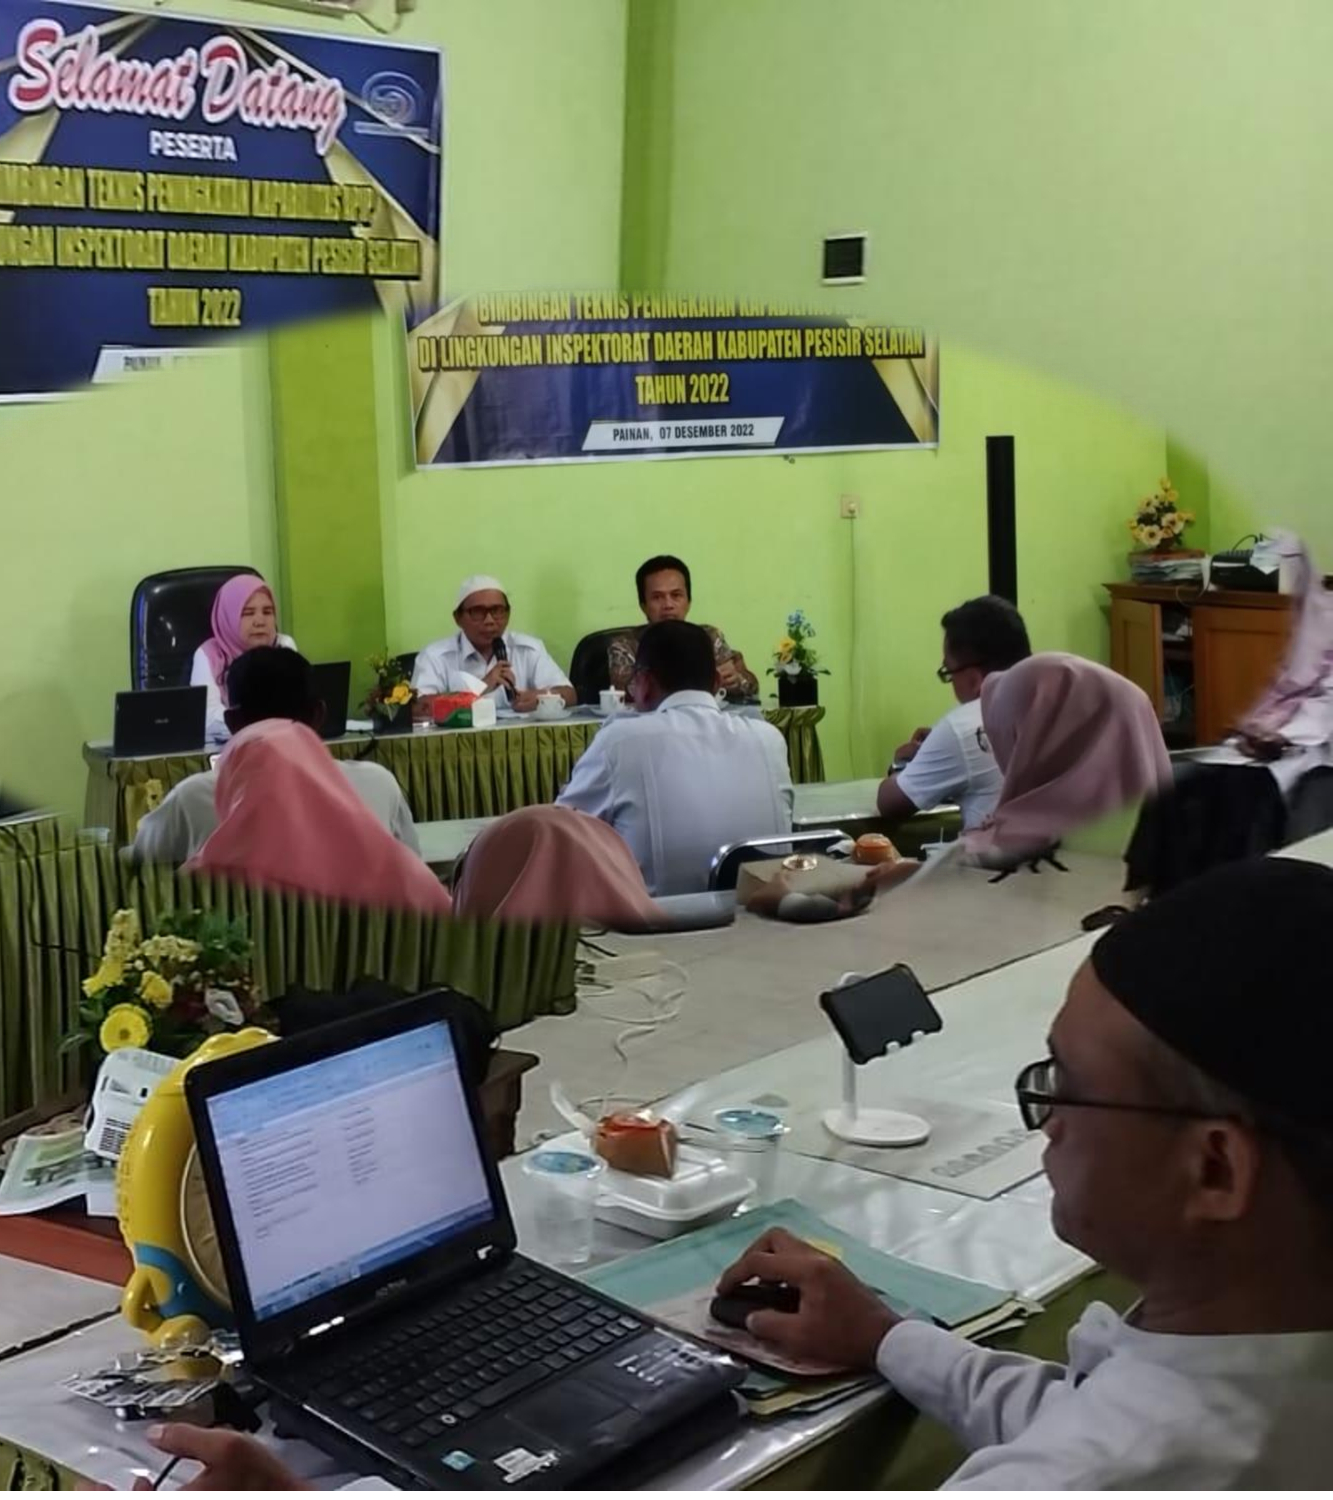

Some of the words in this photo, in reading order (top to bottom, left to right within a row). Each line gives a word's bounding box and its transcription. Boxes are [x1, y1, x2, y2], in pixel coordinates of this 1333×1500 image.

[9, 19, 196, 120] Selamat
[200, 35, 348, 156] Datang
[149, 130, 238, 161] PESERTA
[201, 287, 242, 327] 2022
[477, 292, 571, 324] BIMBINGAN
[575, 291, 630, 321] TEKNIS
[417, 336, 437, 369] DI
[440, 334, 542, 368] LINGKUNGAN
[547, 332, 651, 365] INSPEKTORAT
[654, 330, 714, 362] DAERAH
[717, 328, 802, 360] KABUPATEN
[805, 327, 862, 358] PESISIR
[865, 326, 925, 357] SELATAN
[635, 374, 686, 405] TAHUN
[689, 373, 730, 403] 2022
[613, 427, 654, 442] PAINAN,
[659, 426, 672, 439] 07
[674, 424, 728, 439] DESEMBER
[730, 423, 754, 437] 2022
